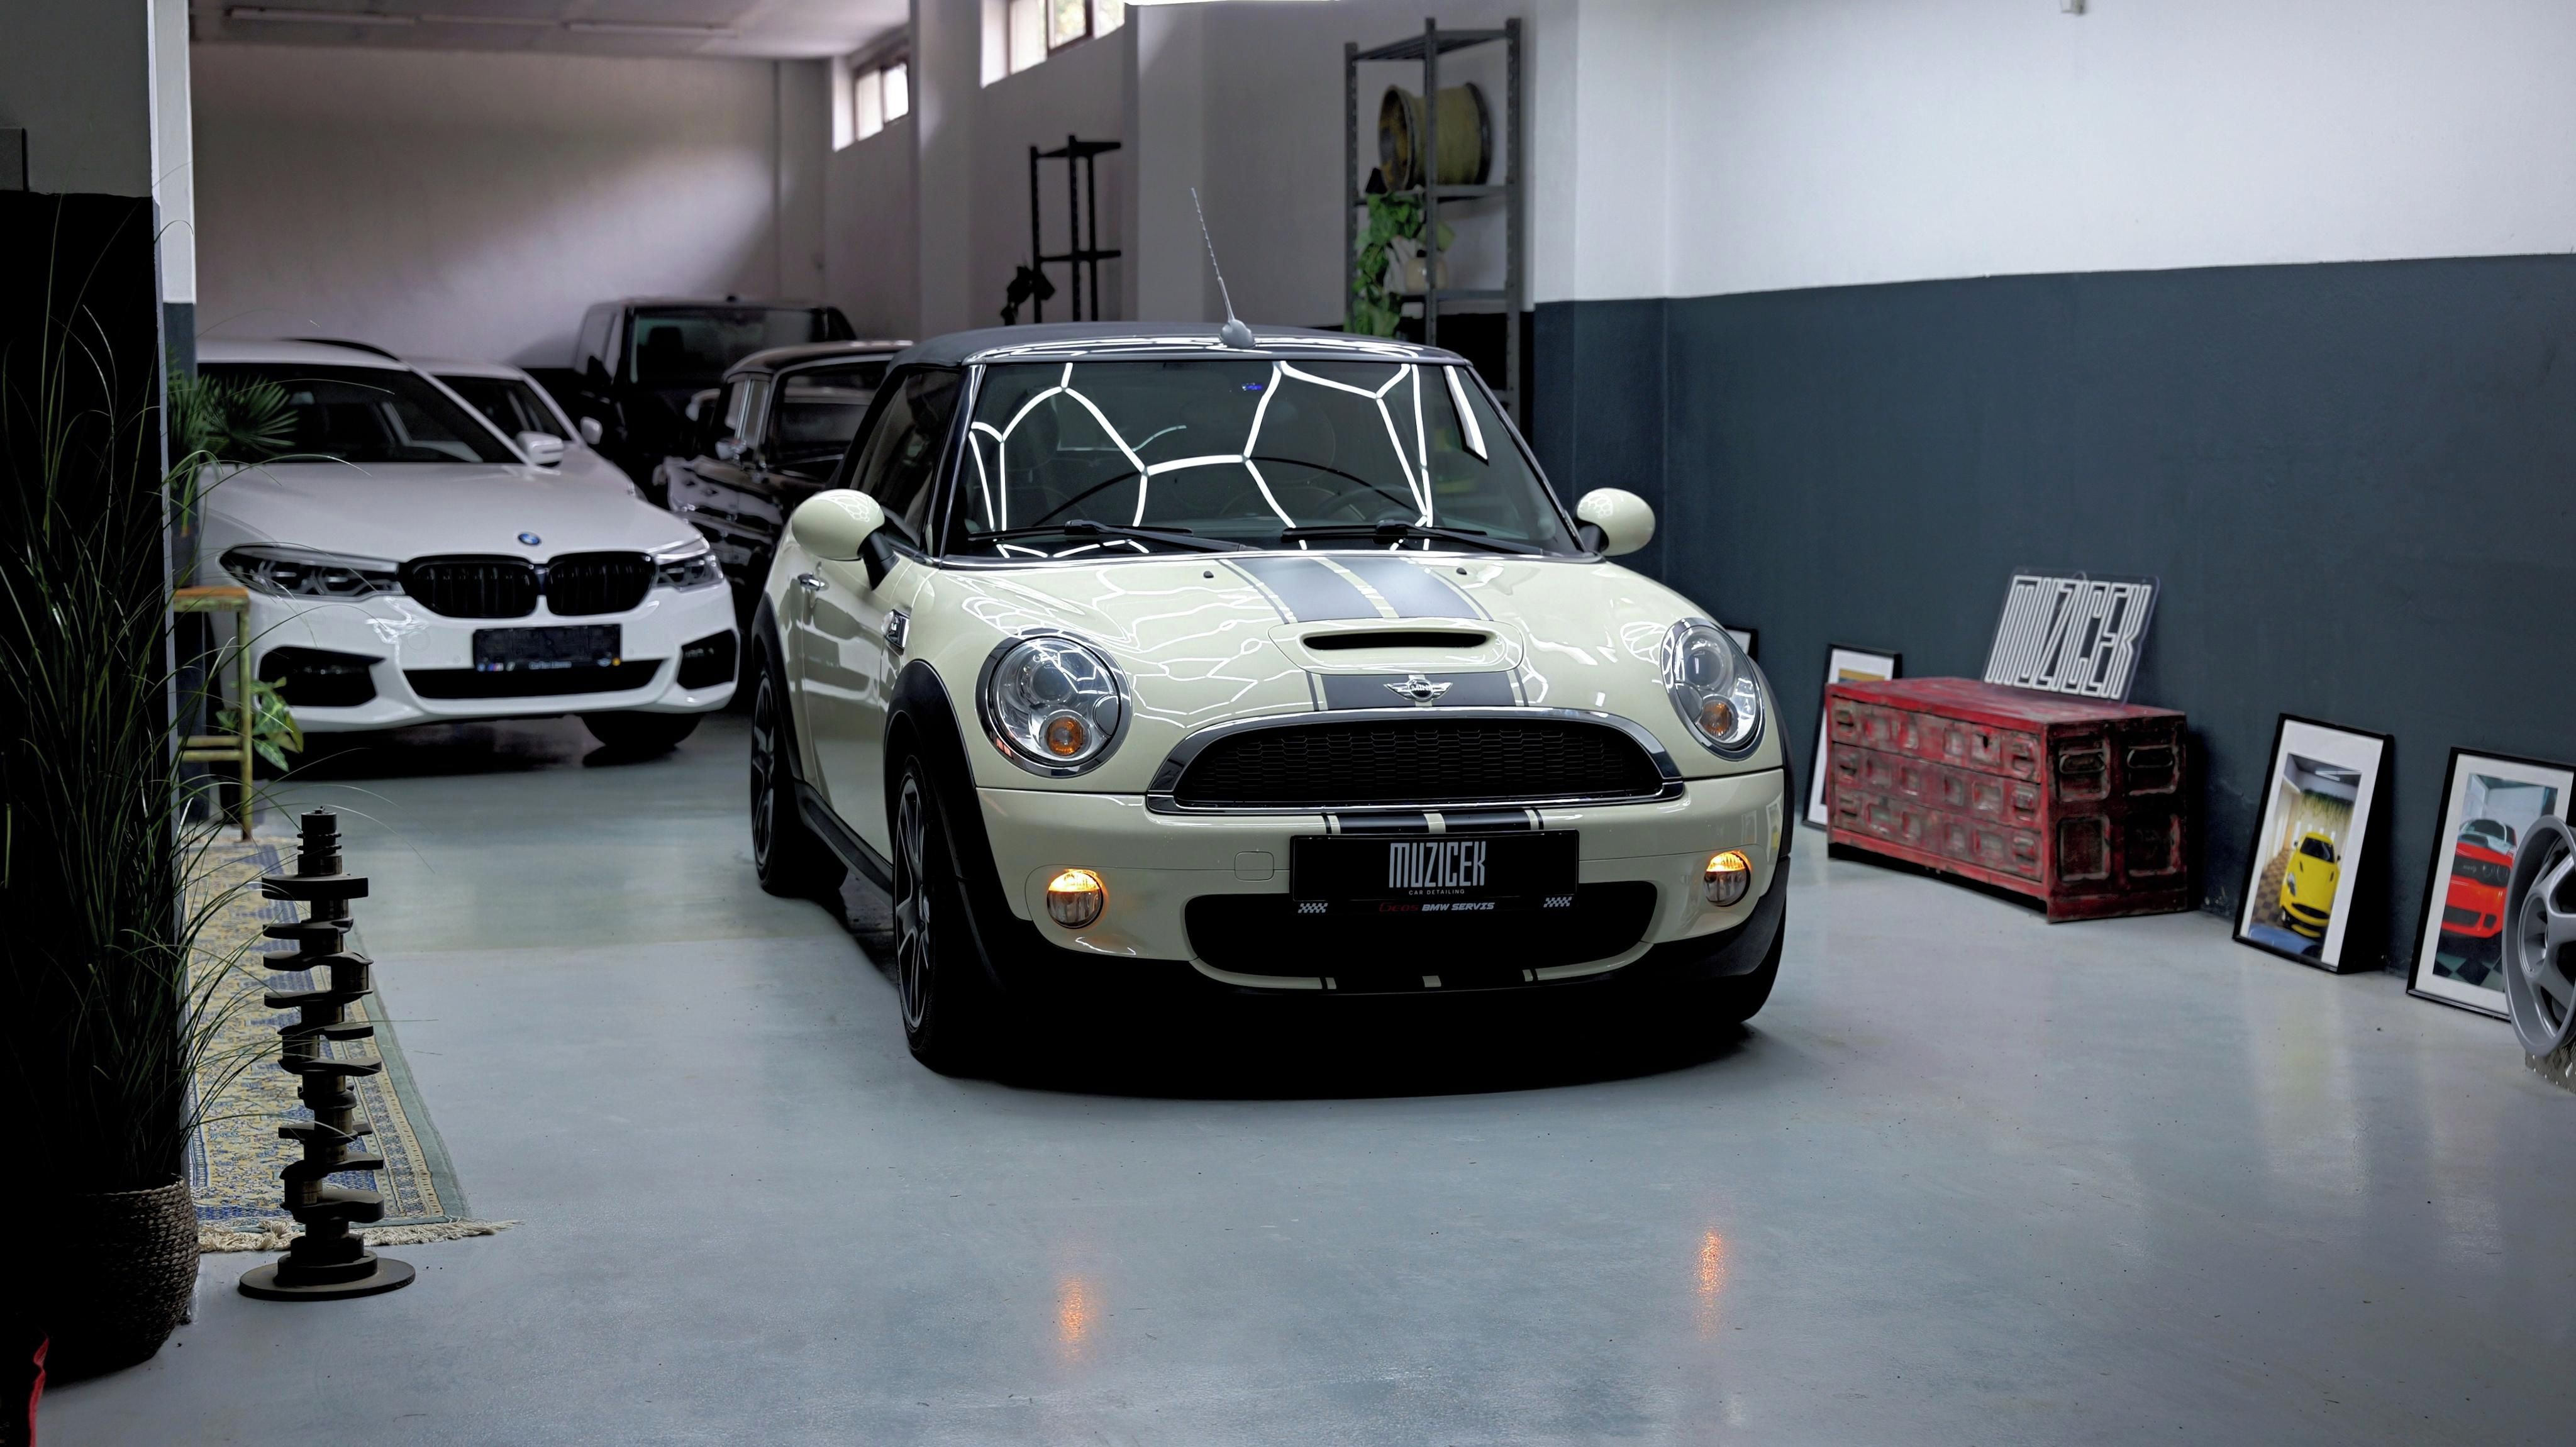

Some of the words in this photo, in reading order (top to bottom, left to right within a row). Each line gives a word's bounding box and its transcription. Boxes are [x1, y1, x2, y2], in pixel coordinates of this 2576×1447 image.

[1984, 575, 2152, 701] MUZICEK
[1389, 841, 1486, 888] MUZICEK
[1451, 902, 1496, 911] SERVIS
